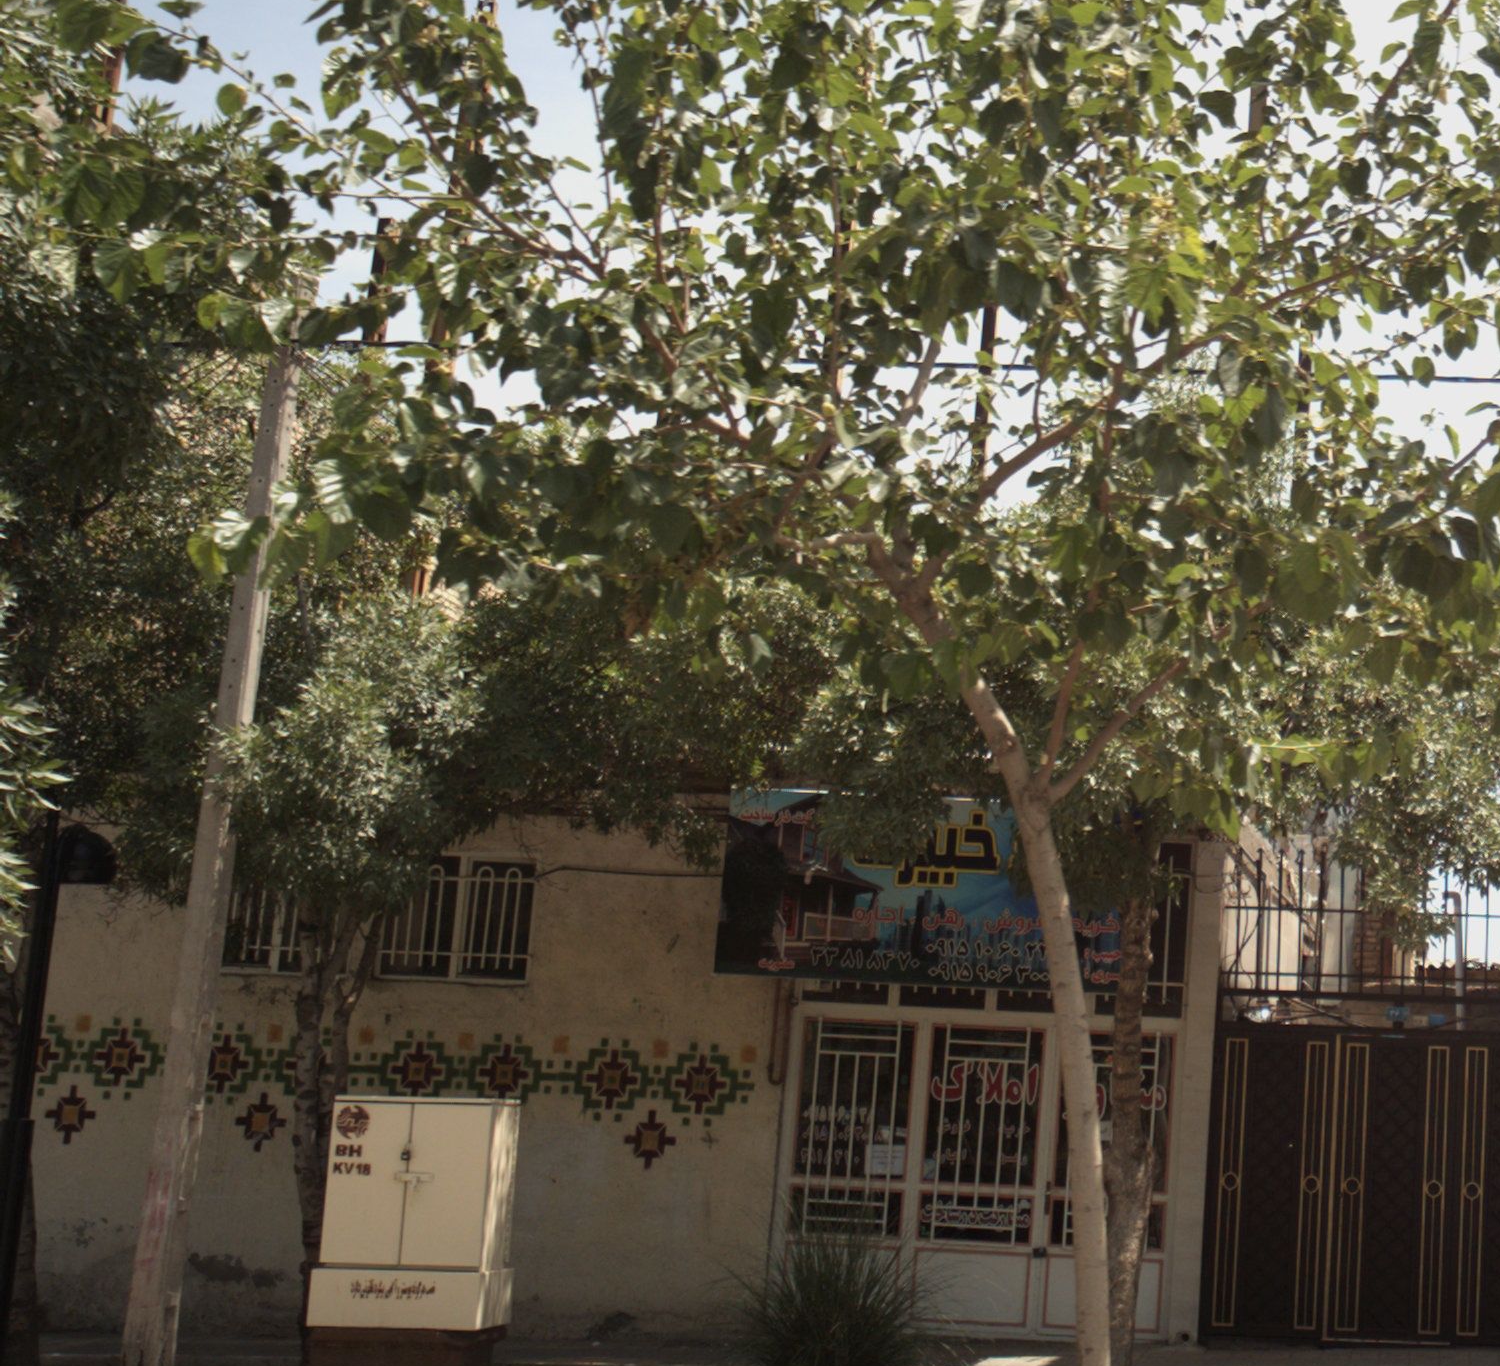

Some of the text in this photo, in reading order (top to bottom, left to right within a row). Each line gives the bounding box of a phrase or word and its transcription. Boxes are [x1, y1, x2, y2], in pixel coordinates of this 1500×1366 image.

[852, 905, 905, 925] اجاره
[931, 1061, 1040, 1106] املاک
[335, 1143, 363, 1158] BH
